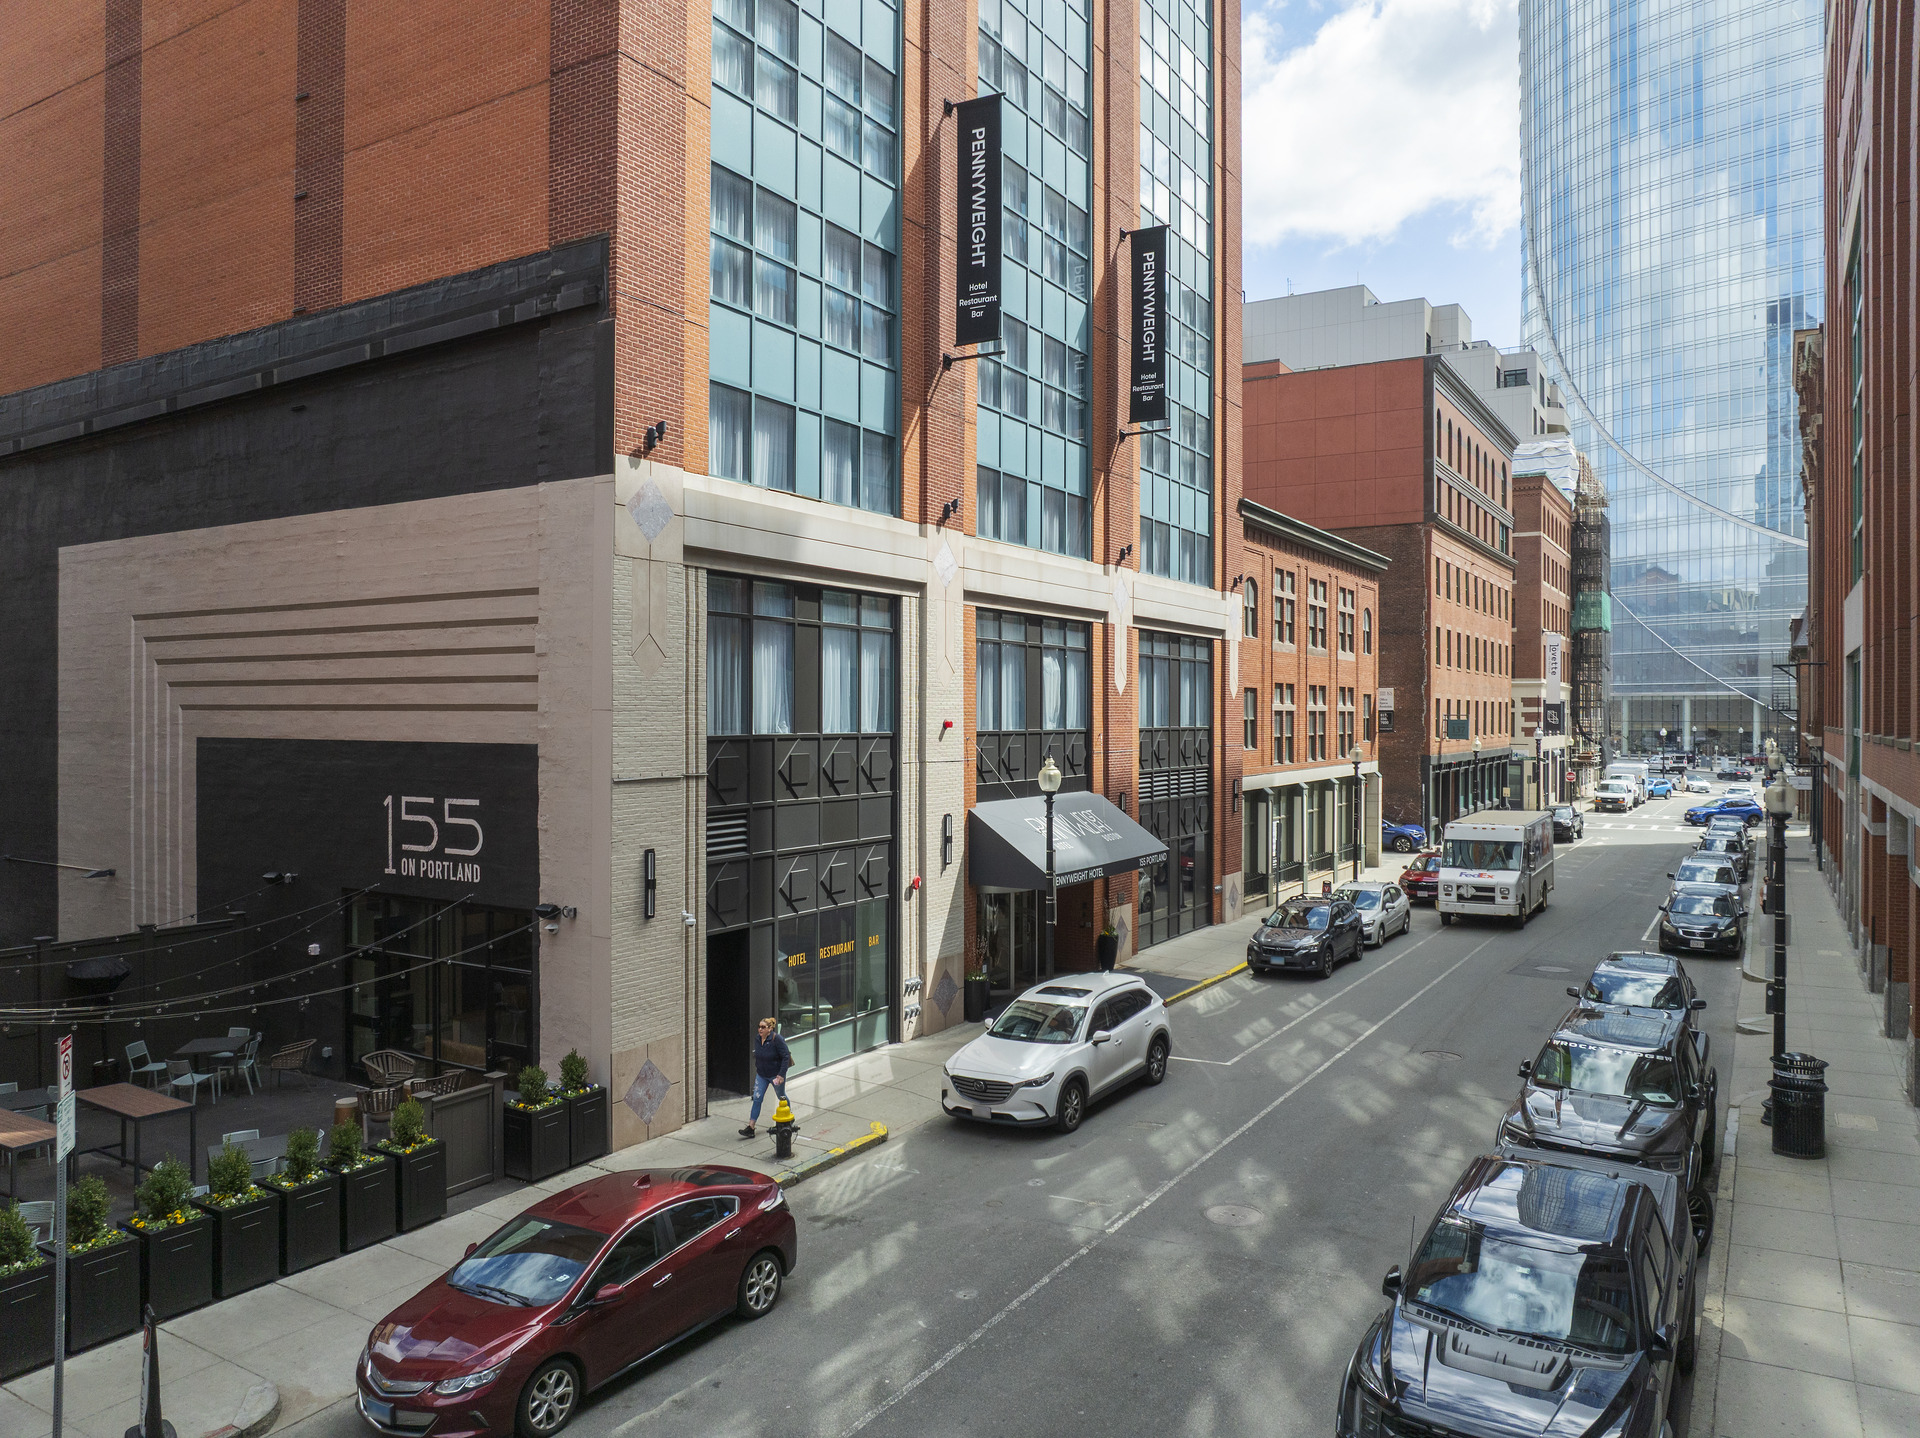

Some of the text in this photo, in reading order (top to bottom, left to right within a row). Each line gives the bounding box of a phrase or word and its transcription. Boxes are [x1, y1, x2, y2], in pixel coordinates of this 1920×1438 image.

[971, 127, 986, 267] PENNYWEIGHT
[968, 281, 988, 291] Hotel
[959, 294, 998, 307] Restaurant
[1142, 251, 1155, 363] PENNYWEIGHT
[971, 310, 984, 318] Bar
[1140, 372, 1157, 381] Hotel
[1132, 382, 1164, 392] Restaurant
[383, 795, 484, 875] 155
[1146, 852, 1168, 865] PORTLAND
[401, 858, 481, 883] ON PORTLAND
[1056, 867, 1104, 886] ENNYWEIGHT HOTEL
[1459, 871, 1495, 879] FedEx
[788, 934, 880, 967] HOTEL RESTAURANT BAR
[1560, 1041, 1607, 1052] ROCKY
